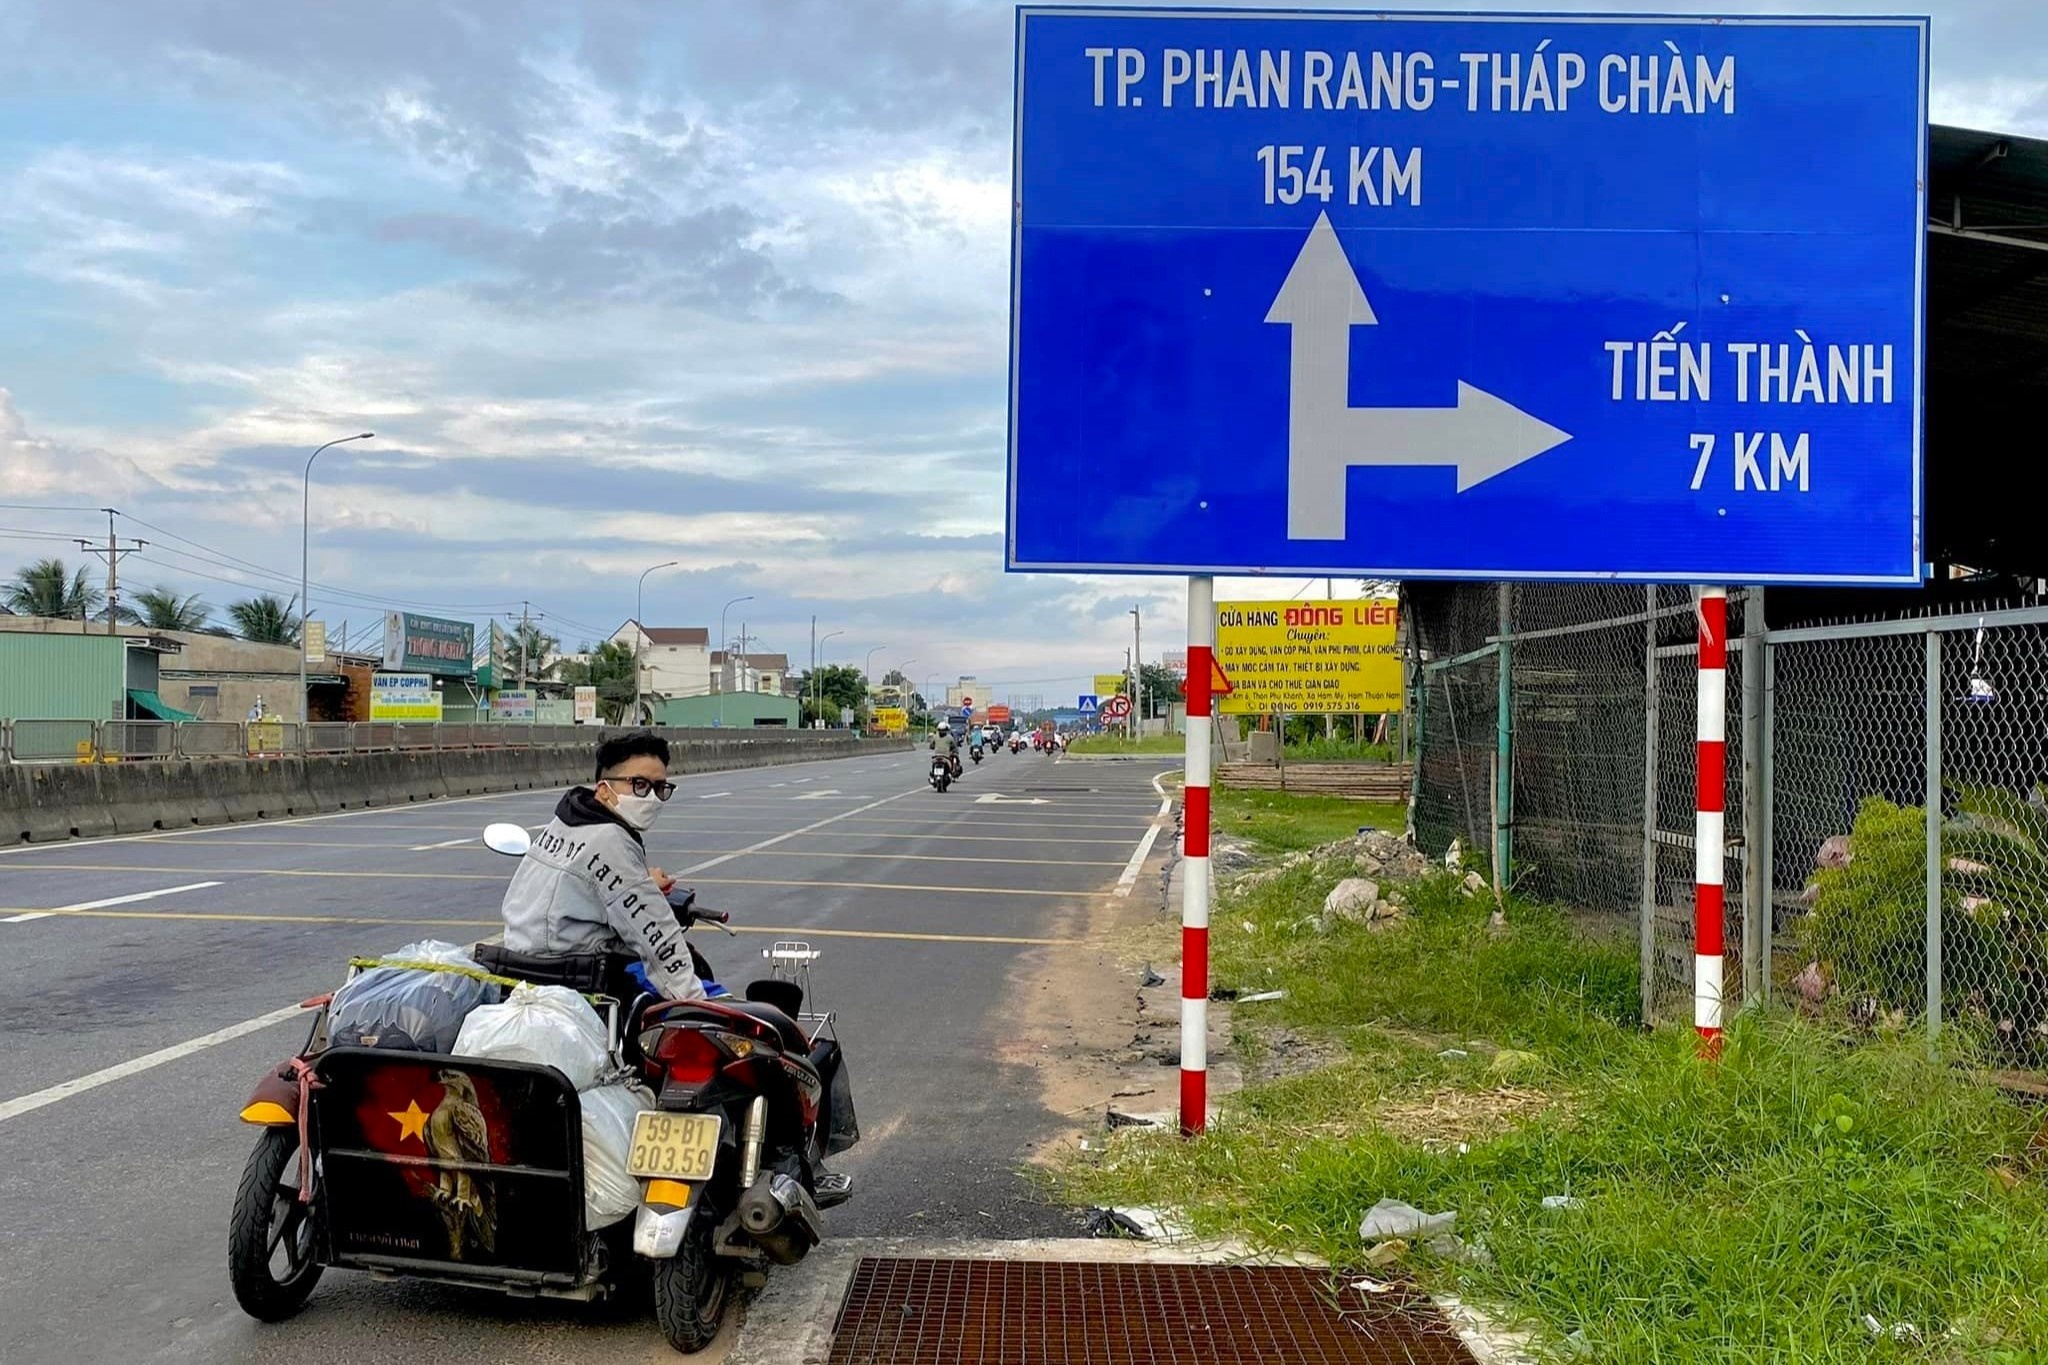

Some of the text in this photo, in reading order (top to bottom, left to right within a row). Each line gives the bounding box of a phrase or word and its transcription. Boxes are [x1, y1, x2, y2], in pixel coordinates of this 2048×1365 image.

[1085, 47, 1146, 107] TP.
[1162, 48, 1291, 109] PHAN
[1599, 40, 1736, 115] CHÀM
[1256, 145, 1423, 206] 154 KM
[1603, 321, 1894, 404] TIẾN THÀNH
[1689, 432, 1810, 492] 7 KM
[1220, 605, 1243, 626] CỬA
[1247, 607, 1278, 627] HÀNG
[1283, 602, 1344, 626] ĐÔNG
[1286, 628, 1331, 645] Chuyên:
[642, 920, 688, 975] cards
[633, 1145, 710, 1174] 303.59
[646, 1117, 705, 1147] 59-B1
